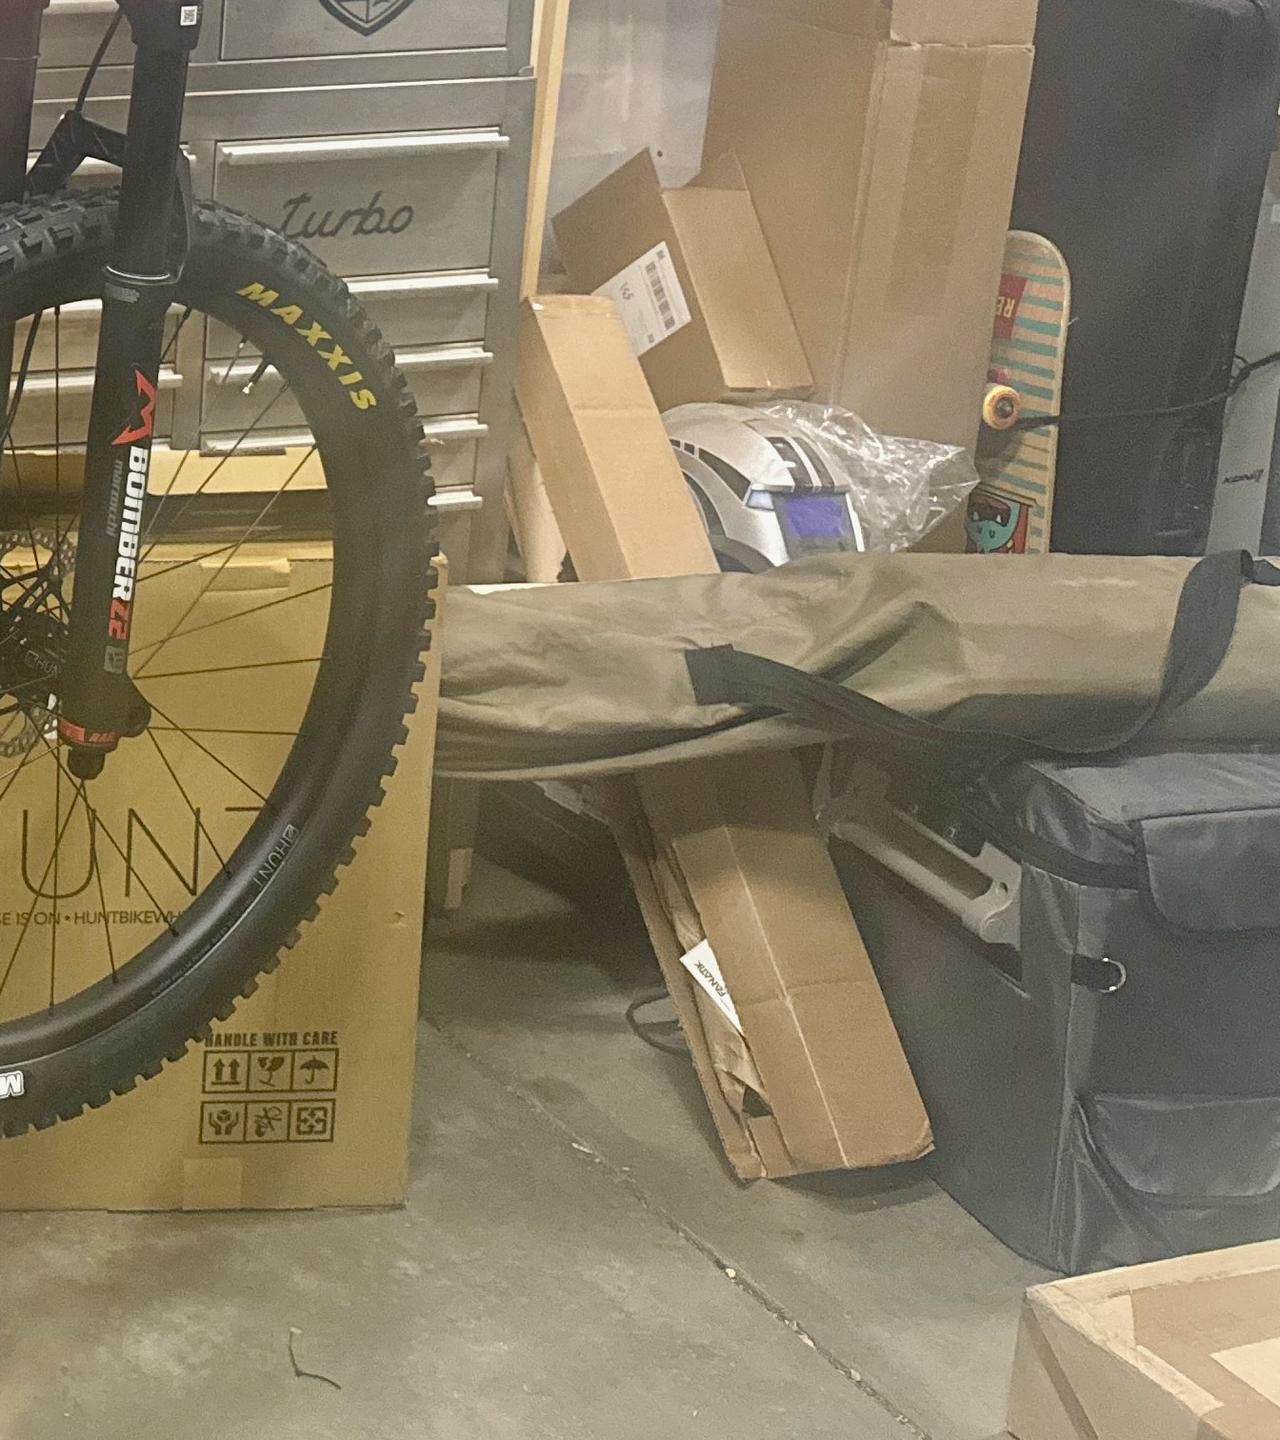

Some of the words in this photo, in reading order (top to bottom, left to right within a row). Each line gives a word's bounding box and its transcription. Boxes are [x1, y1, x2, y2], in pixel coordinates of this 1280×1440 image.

[277, 193, 415, 242] Turbo
[235, 282, 378, 410] MAXXIS
[105, 458, 122, 538] marzocchi
[112, 445, 149, 603] BOMBER
[107, 598, 133, 641] Z2
[15, 911, 28, 926] IS
[33, 911, 62, 927] ON
[692, 958, 731, 1000] FANATIK
[204, 1032, 258, 1048] HANDLE
[263, 1031, 298, 1047] WITH
[302, 1030, 338, 1046] CARE
